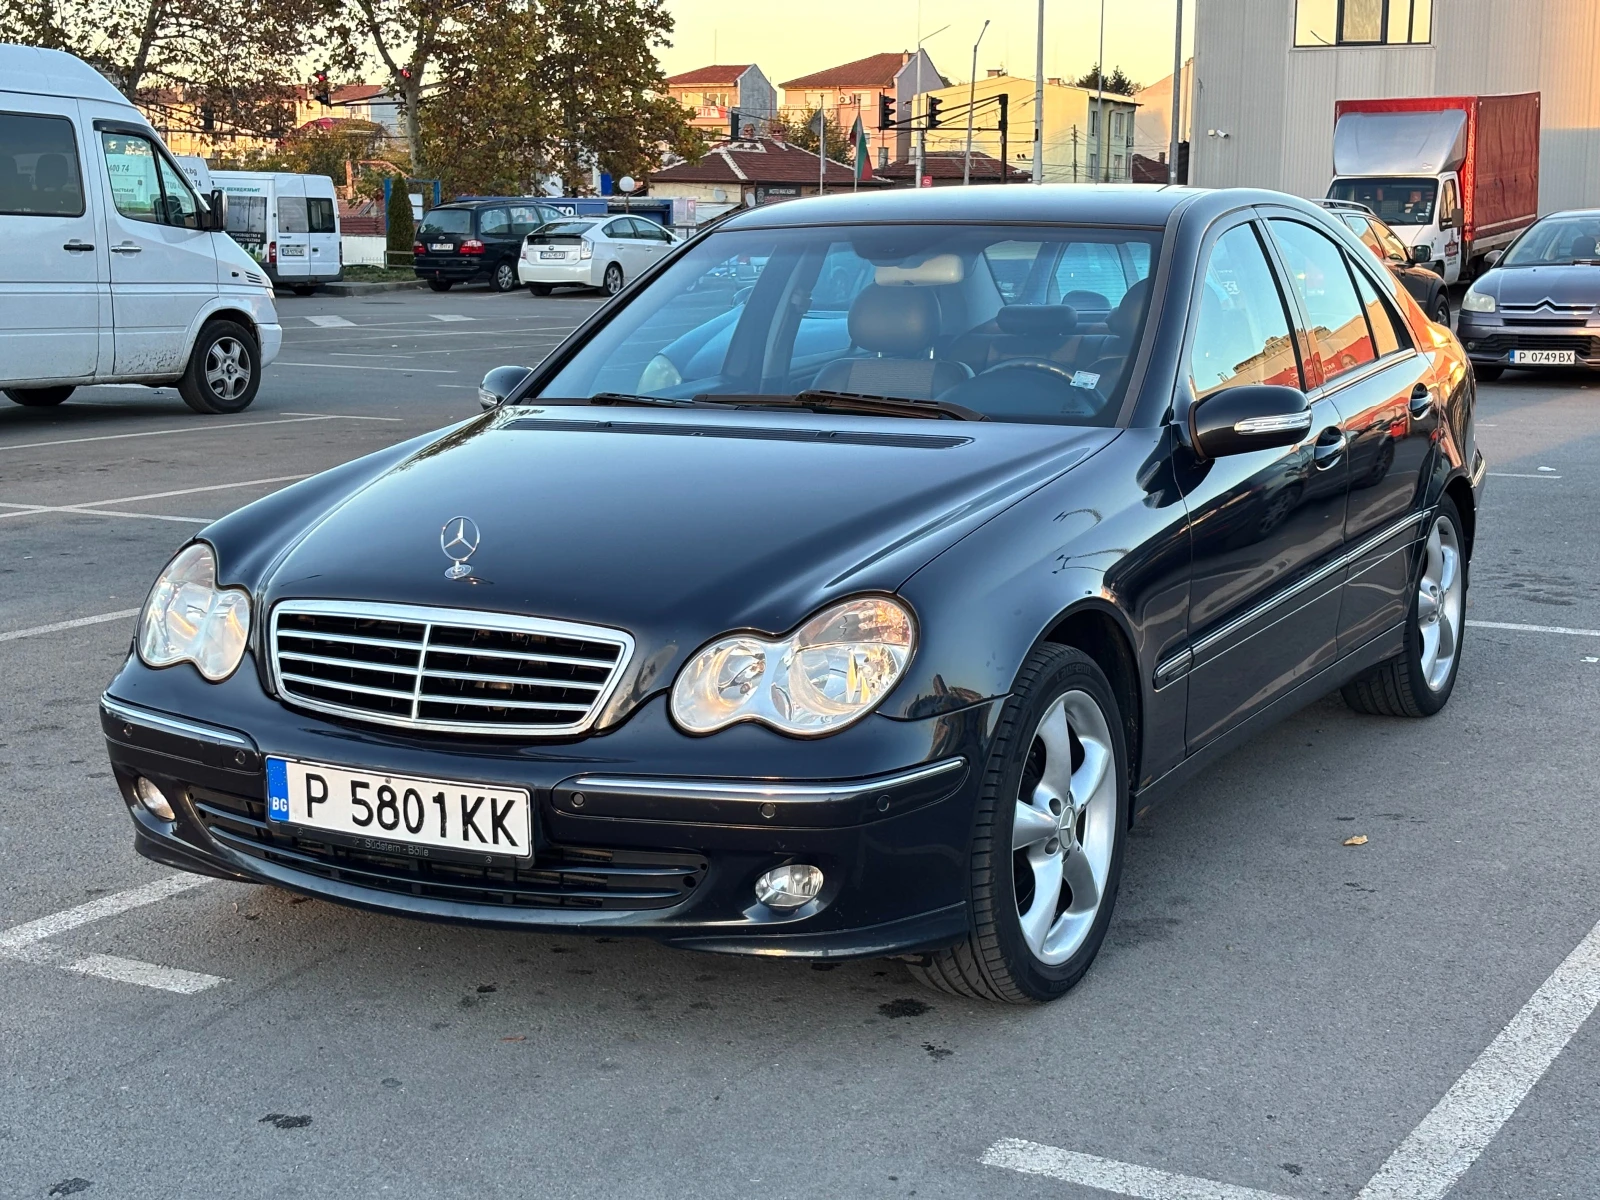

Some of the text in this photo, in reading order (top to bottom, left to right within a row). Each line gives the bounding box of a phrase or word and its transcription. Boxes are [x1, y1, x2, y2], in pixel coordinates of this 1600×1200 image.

[1519, 352, 1526, 362] P
[305, 772, 329, 818] P
[272, 796, 288, 812] BG
[365, 838, 401, 853] Südstern
